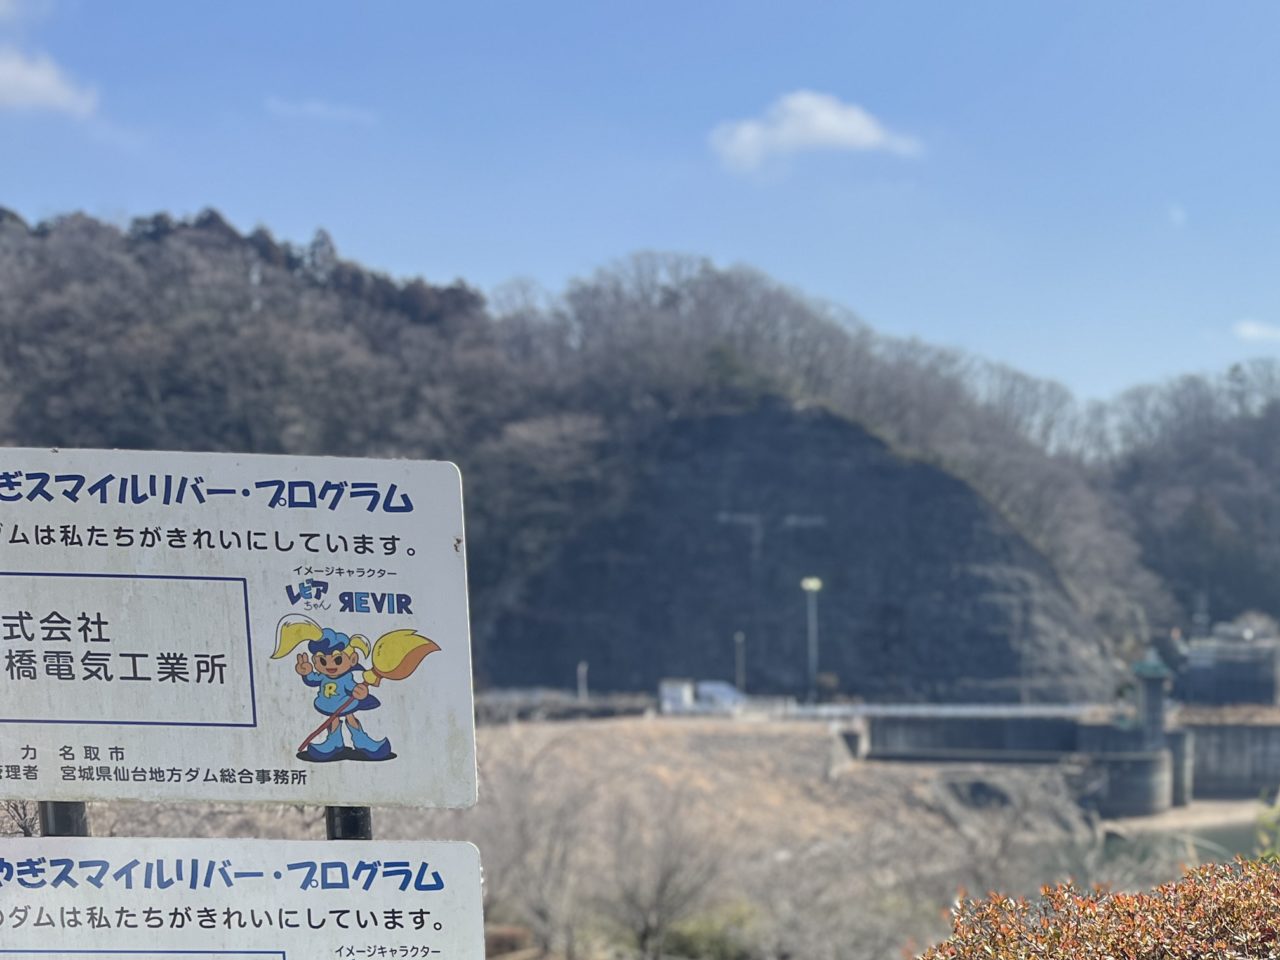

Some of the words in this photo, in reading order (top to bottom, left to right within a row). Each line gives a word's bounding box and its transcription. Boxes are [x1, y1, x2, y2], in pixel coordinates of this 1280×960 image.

[0, 522, 415, 557] ムは私たちがきれいにしています。
[293, 566, 397, 578] イメージキャラクター
[1, 611, 110, 643] 式会社
[5, 649, 227, 684] 橋電気工業所
[59, 745, 125, 761] 名取市
[0, 764, 39, 781] 理者
[60, 764, 307, 786] 宮城県仙台地方ダム総合事務所
[0, 904, 444, 932] ダムは私たちがきれいにしています。
[335, 945, 441, 958] イメージキャラクター
